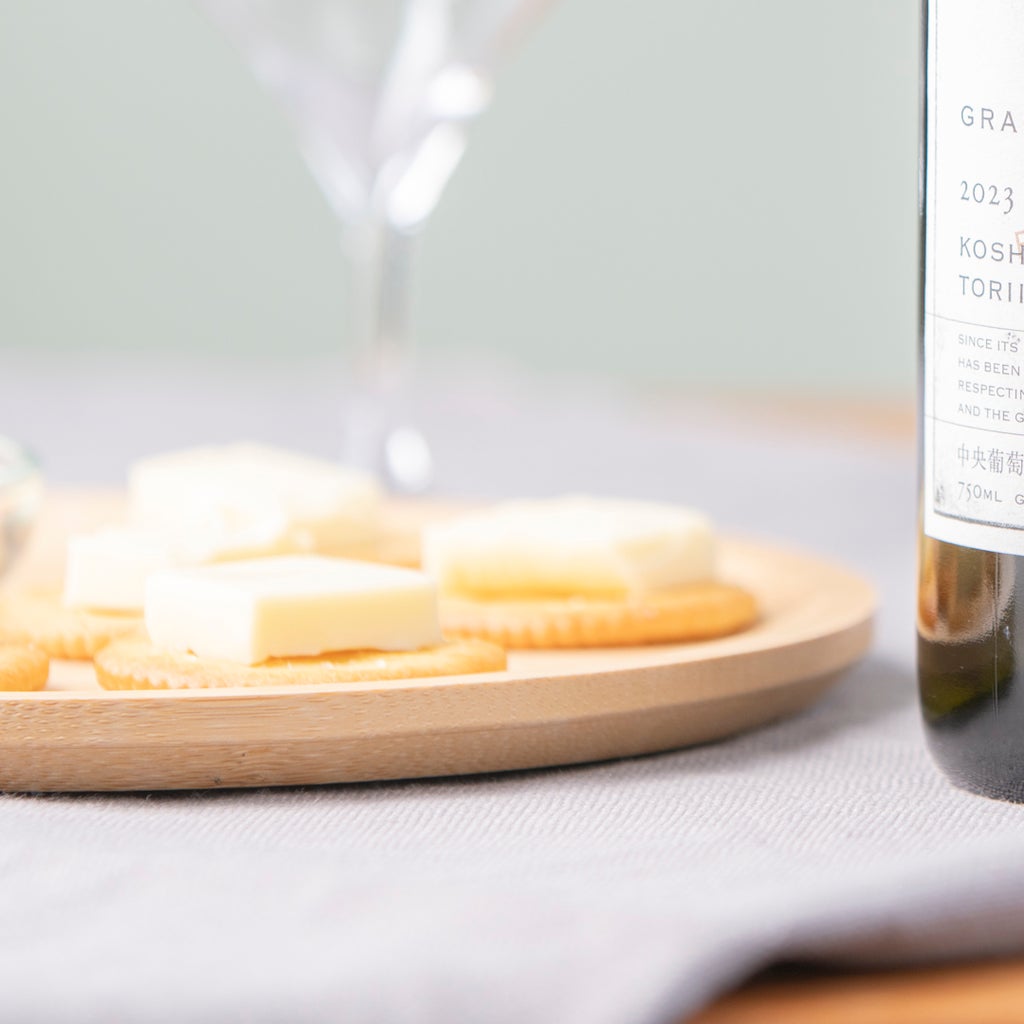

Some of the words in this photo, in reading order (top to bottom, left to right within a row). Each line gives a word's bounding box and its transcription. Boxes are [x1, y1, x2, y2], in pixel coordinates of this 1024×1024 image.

[959, 180, 1015, 215] 2023
[958, 333, 993, 350] SINCE
[997, 340, 1019, 353] ITS
[958, 357, 981, 371] HAS
[984, 361, 1021, 377] BEEN
[958, 403, 981, 417] AND
[985, 408, 1011, 422] THE
